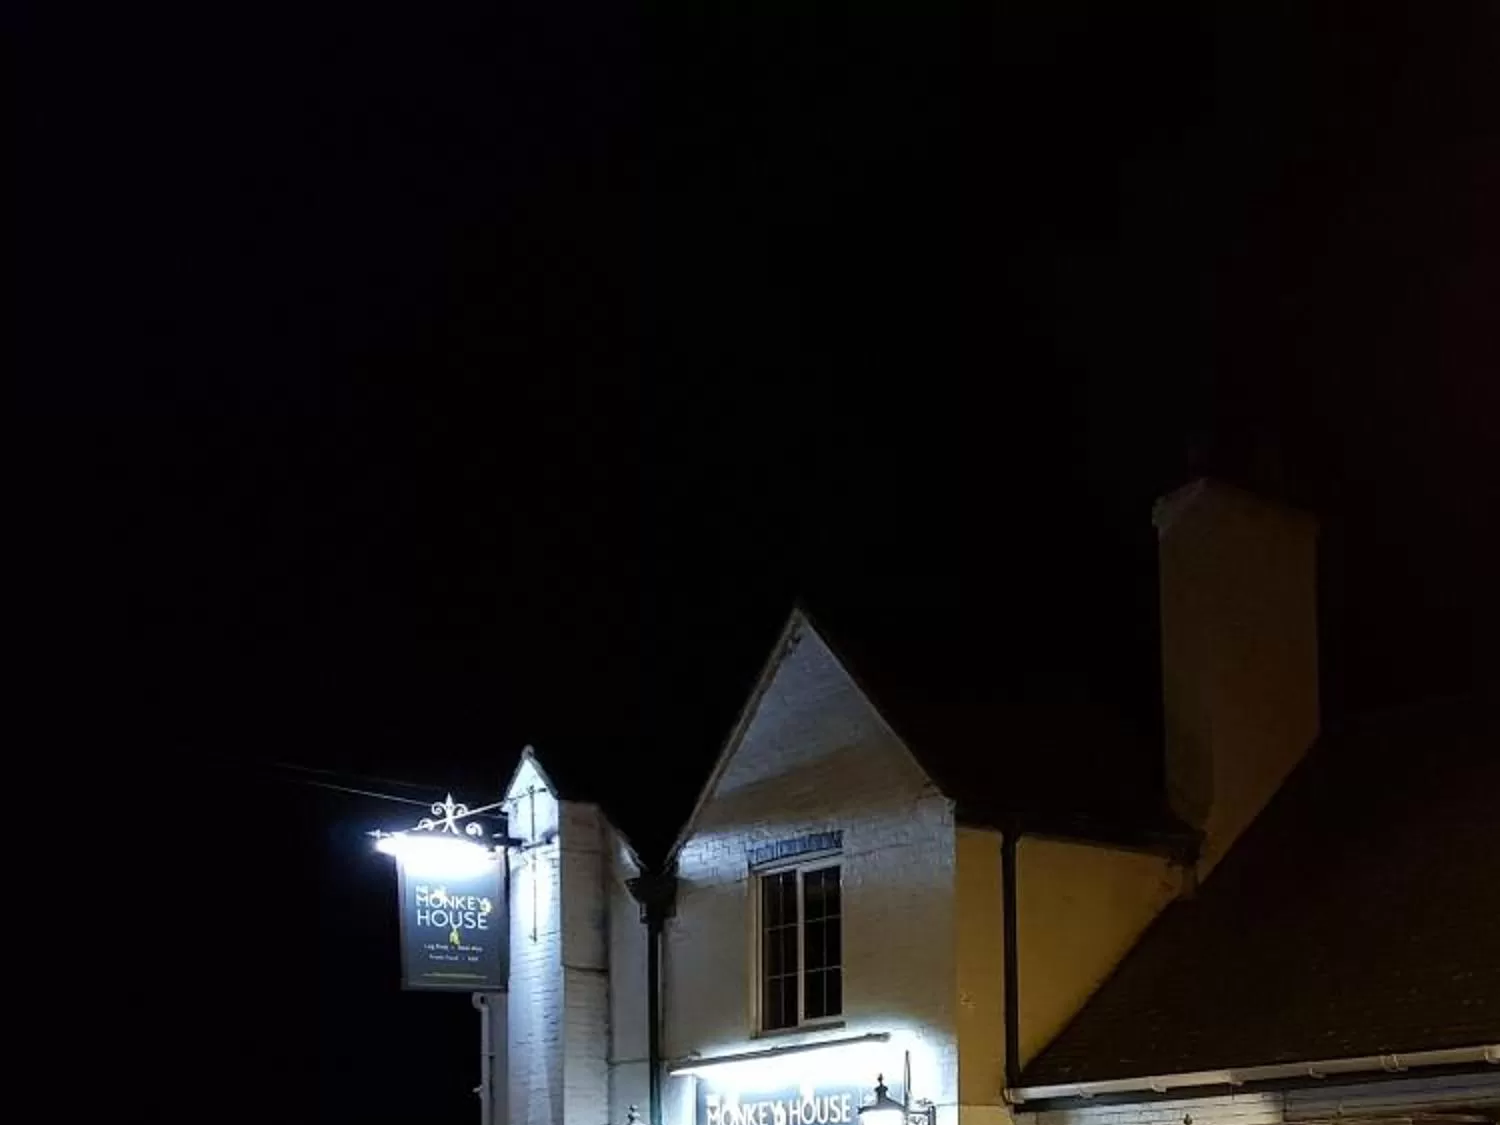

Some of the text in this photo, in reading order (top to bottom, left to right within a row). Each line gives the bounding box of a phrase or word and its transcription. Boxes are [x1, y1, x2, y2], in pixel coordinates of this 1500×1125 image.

[415, 894, 491, 911] MONKEY
[417, 909, 489, 930] HOUSE
[789, 1094, 852, 1125] HOUSE
